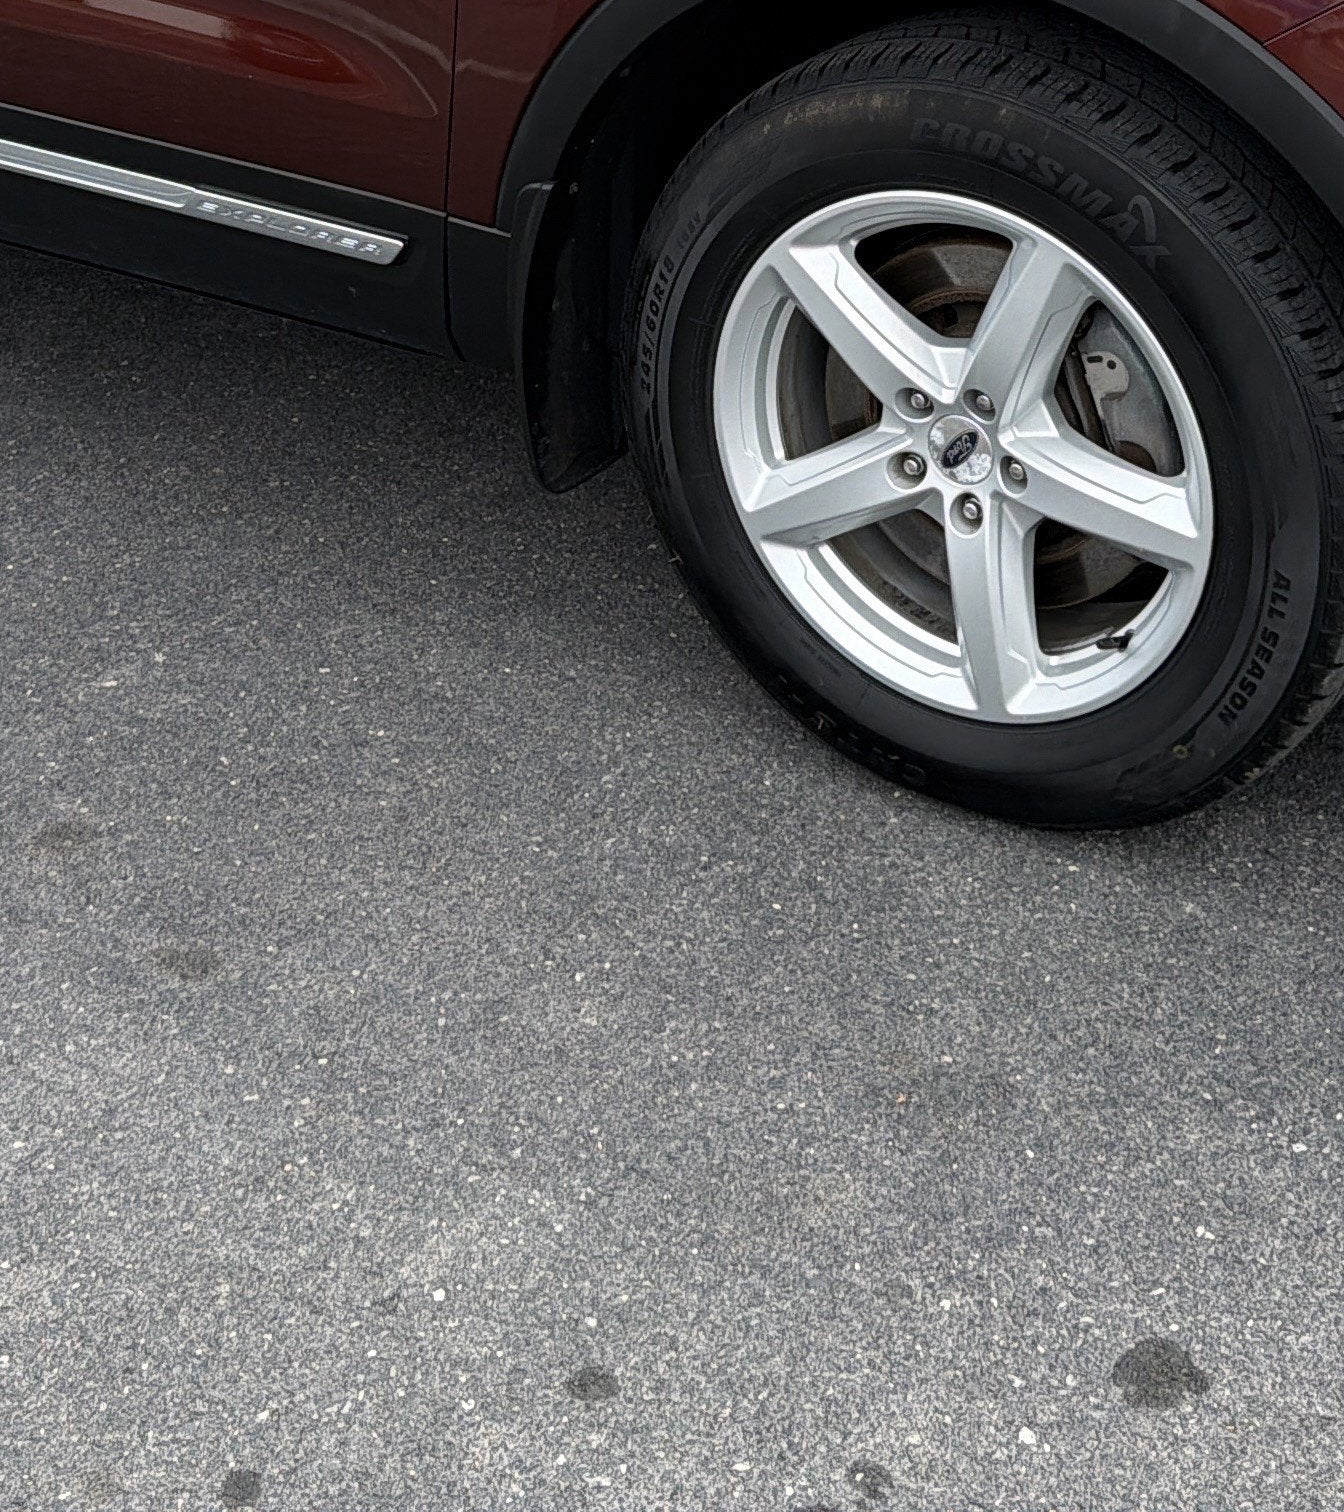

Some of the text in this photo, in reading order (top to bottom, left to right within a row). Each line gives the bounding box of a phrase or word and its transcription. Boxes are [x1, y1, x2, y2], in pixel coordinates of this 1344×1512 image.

[196, 200, 382, 256] EXPLORER
[909, 116, 1173, 272] CROSSMAX
[944, 431, 975, 467] Ford
[1218, 568, 1292, 727] ALL SEASON
